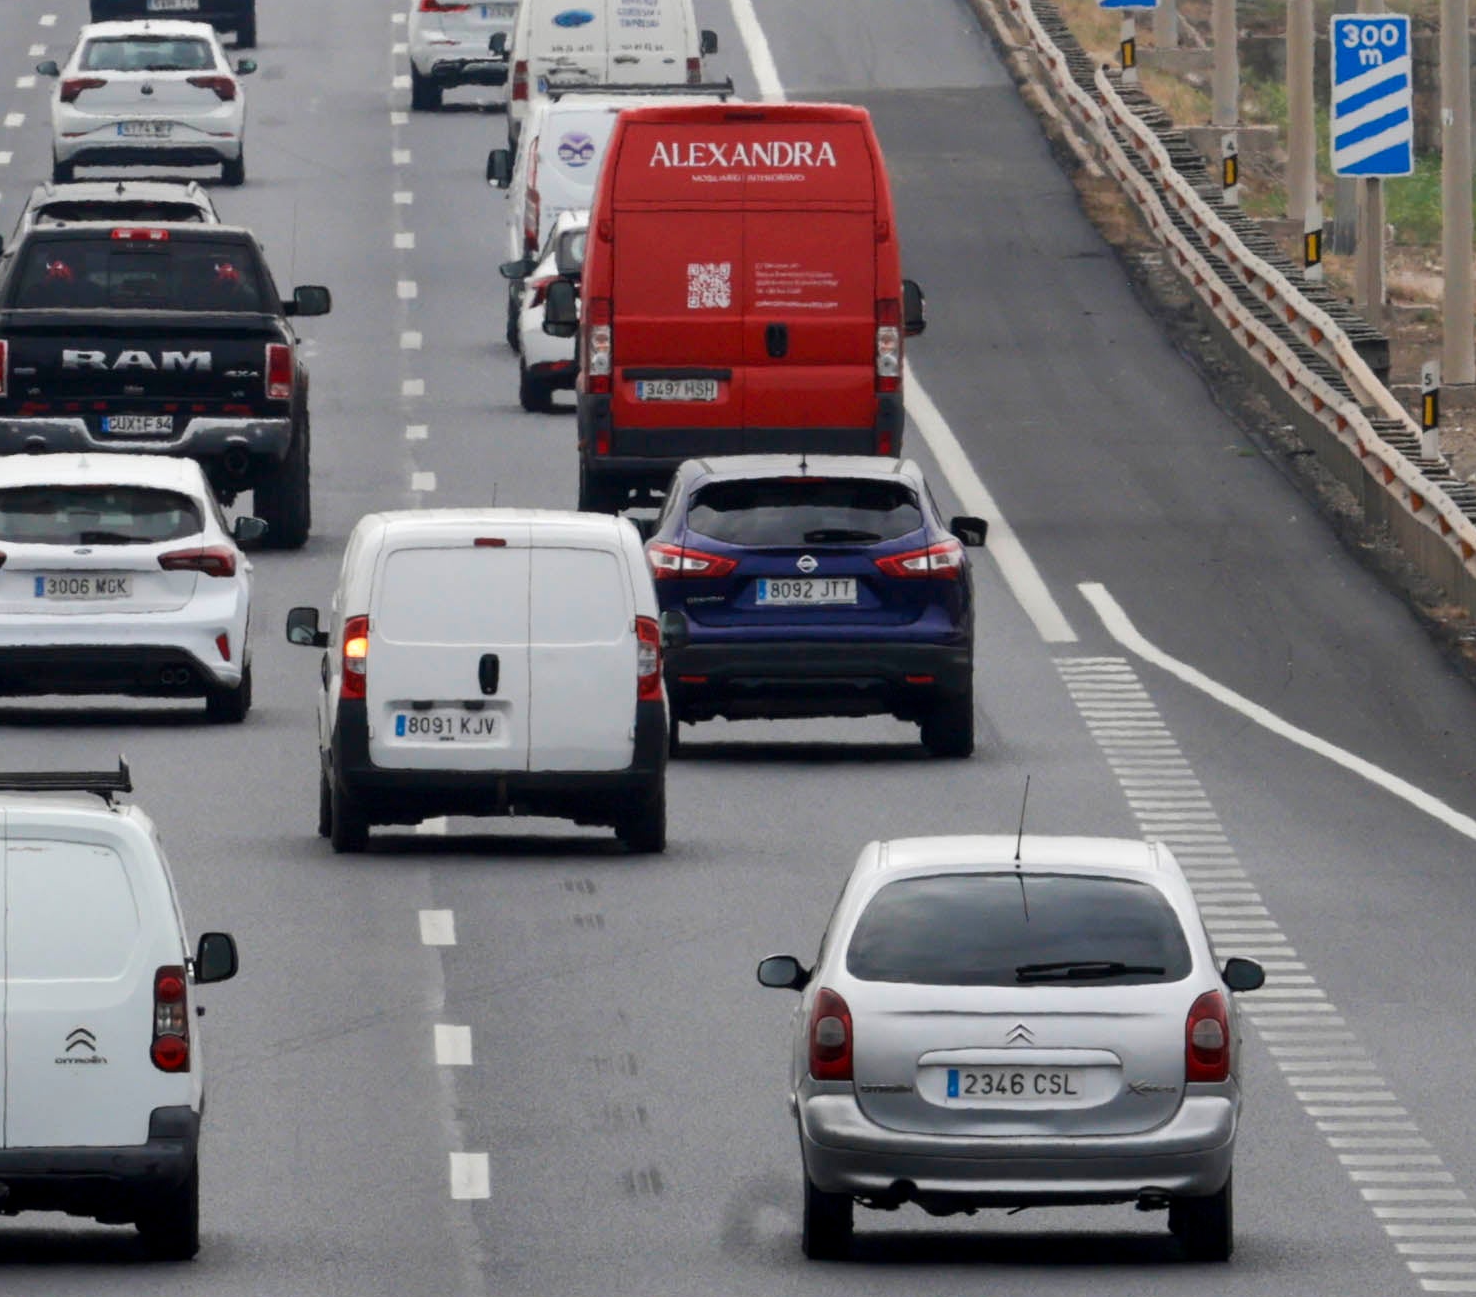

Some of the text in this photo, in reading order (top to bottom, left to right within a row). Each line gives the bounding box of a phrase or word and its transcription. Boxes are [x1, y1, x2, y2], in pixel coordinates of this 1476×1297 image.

[1341, 23, 1400, 48] 300
[1358, 48, 1383, 66] m
[649, 140, 837, 168] ALEXANDRA
[61, 349, 212, 372] RAM
[647, 381, 681, 396] 3497
[1424, 372, 1433, 386] 5
[47, 578, 90, 595] 3006
[769, 579, 853, 599] 8092 JTT
[408, 716, 495, 735] 8091 KJV
[963, 1073, 1078, 1096] 2346 CSL
